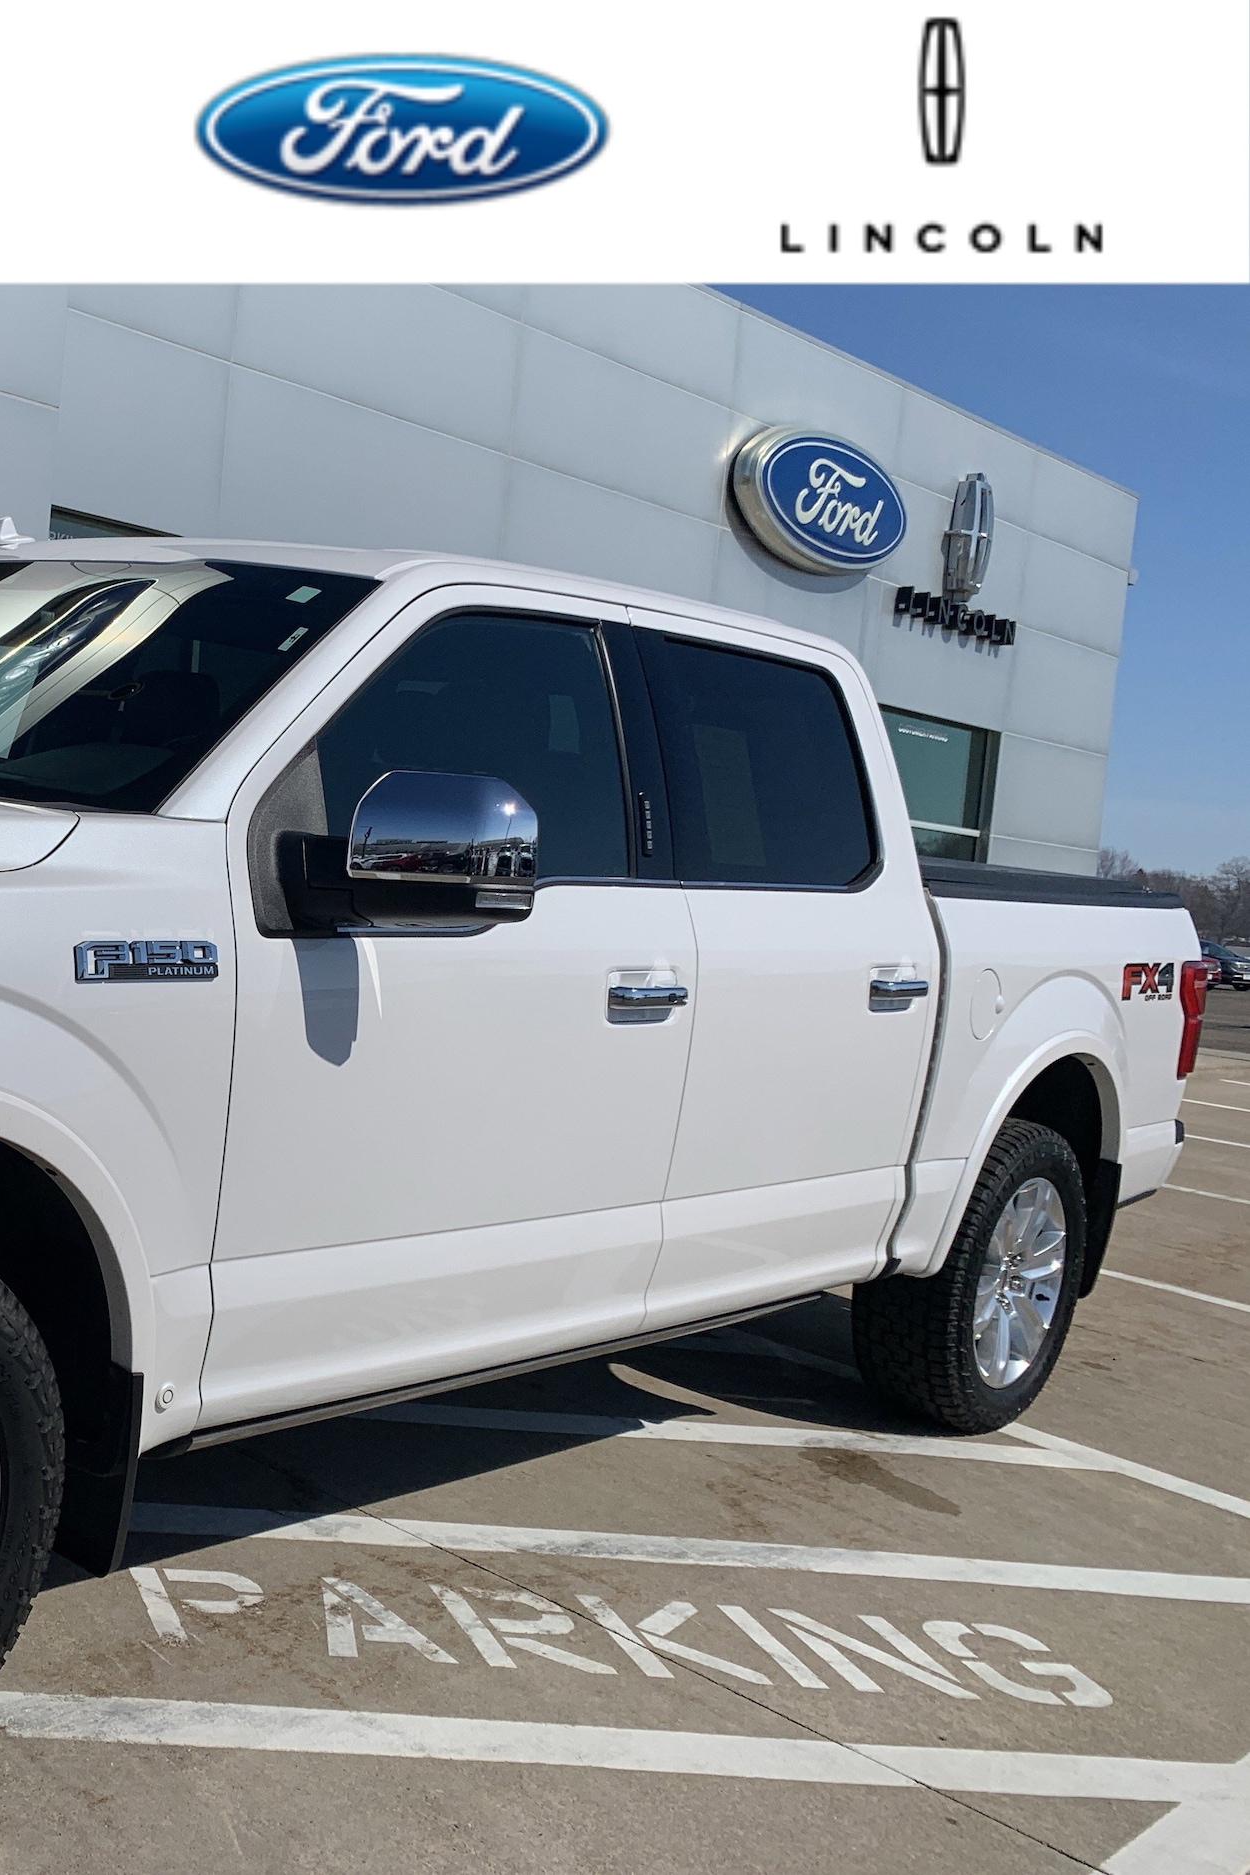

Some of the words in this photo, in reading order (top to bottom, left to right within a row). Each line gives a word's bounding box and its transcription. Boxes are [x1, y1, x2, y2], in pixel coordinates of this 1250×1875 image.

[795, 458, 884, 546] Ford
[148, 966, 215, 976] PLATINUM
[1122, 963, 1174, 1001] FX4
[128, 1566, 1114, 1708] PARKING
